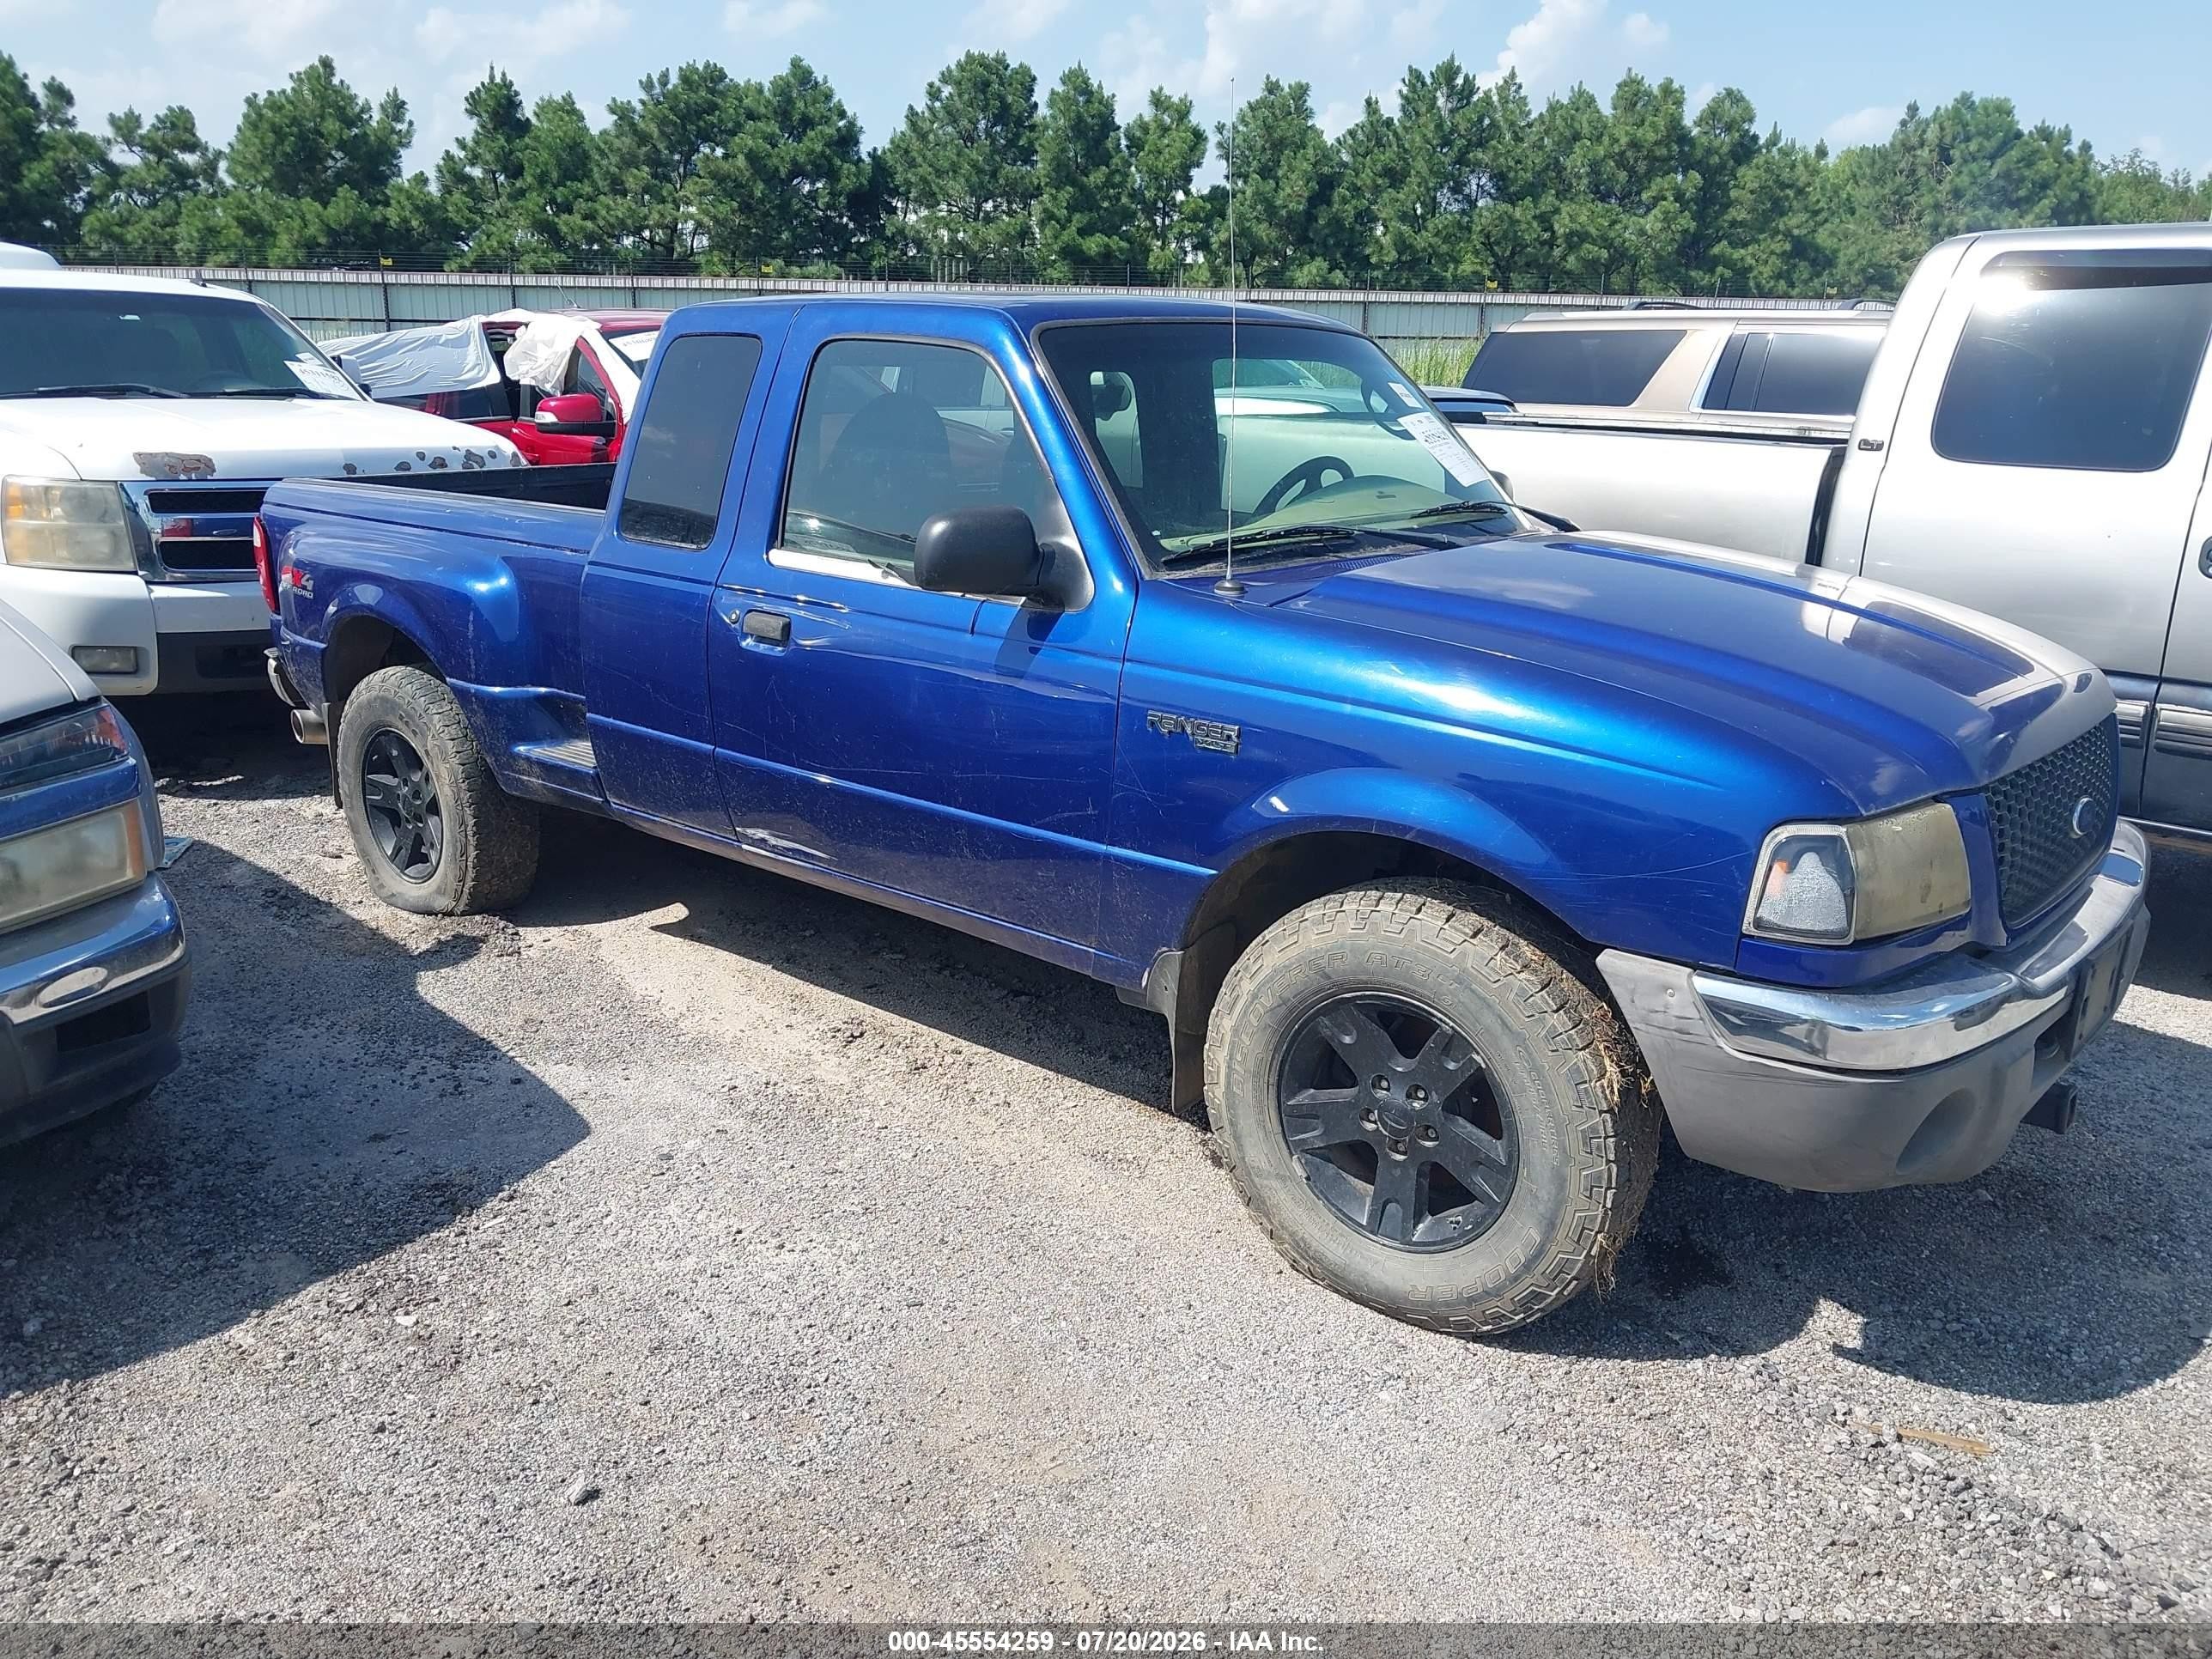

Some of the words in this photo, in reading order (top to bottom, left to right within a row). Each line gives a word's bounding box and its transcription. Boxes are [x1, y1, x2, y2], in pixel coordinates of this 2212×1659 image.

[292, 586, 314, 599] ROAD
[1146, 709, 1239, 741] RANGER
[1231, 951, 1348, 1097] DISCOVERER
[1365, 951, 1432, 981] AT3
[1407, 1226, 1541, 1302] COOPER
